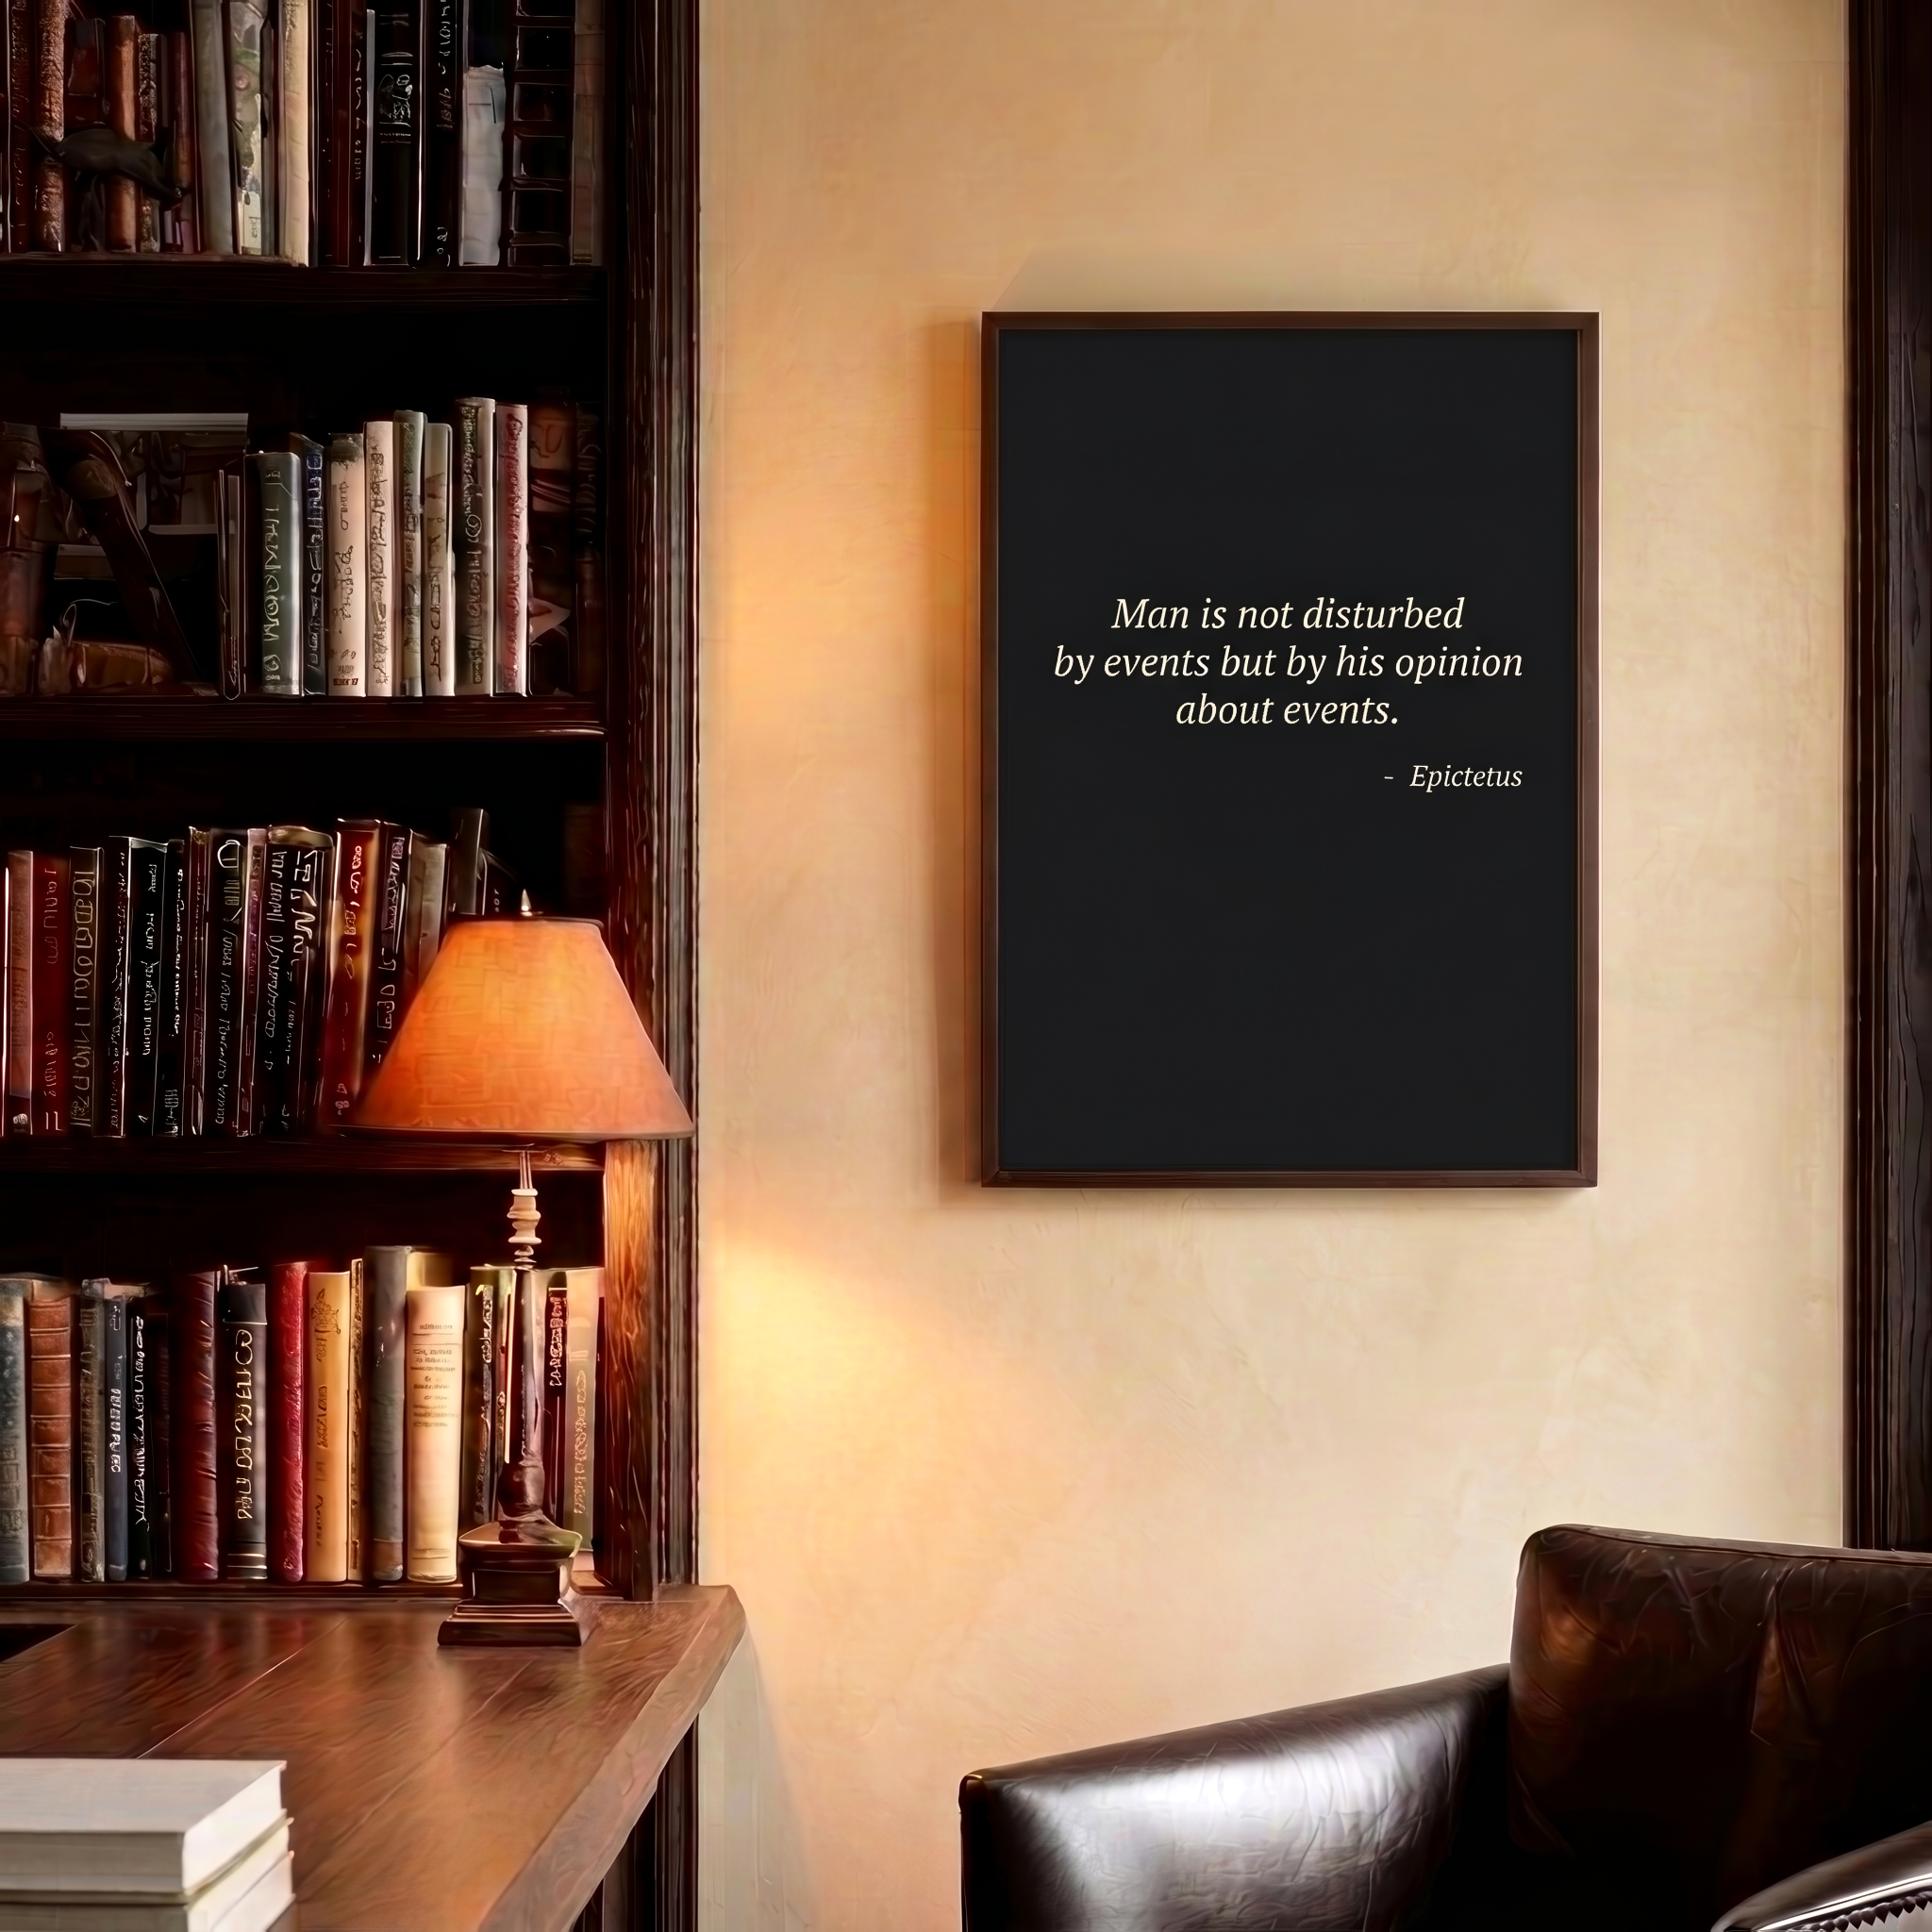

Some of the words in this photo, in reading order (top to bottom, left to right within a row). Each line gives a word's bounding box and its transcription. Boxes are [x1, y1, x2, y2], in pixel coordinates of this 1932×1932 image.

[1111, 599, 1188, 628] Man
[1202, 598, 1226, 628] is
[1239, 603, 1293, 628] not
[1304, 597, 1464, 628] disturbed
[1055, 645, 1094, 684] by
[1105, 651, 1209, 676] events
[1222, 645, 1276, 676] but
[1287, 645, 1326, 684] by
[1337, 645, 1384, 676] his
[1396, 646, 1523, 684] opinion
[1176, 693, 1274, 724] about
[1284, 698, 1398, 724] events.
[1409, 765, 1523, 792] Epictetus
